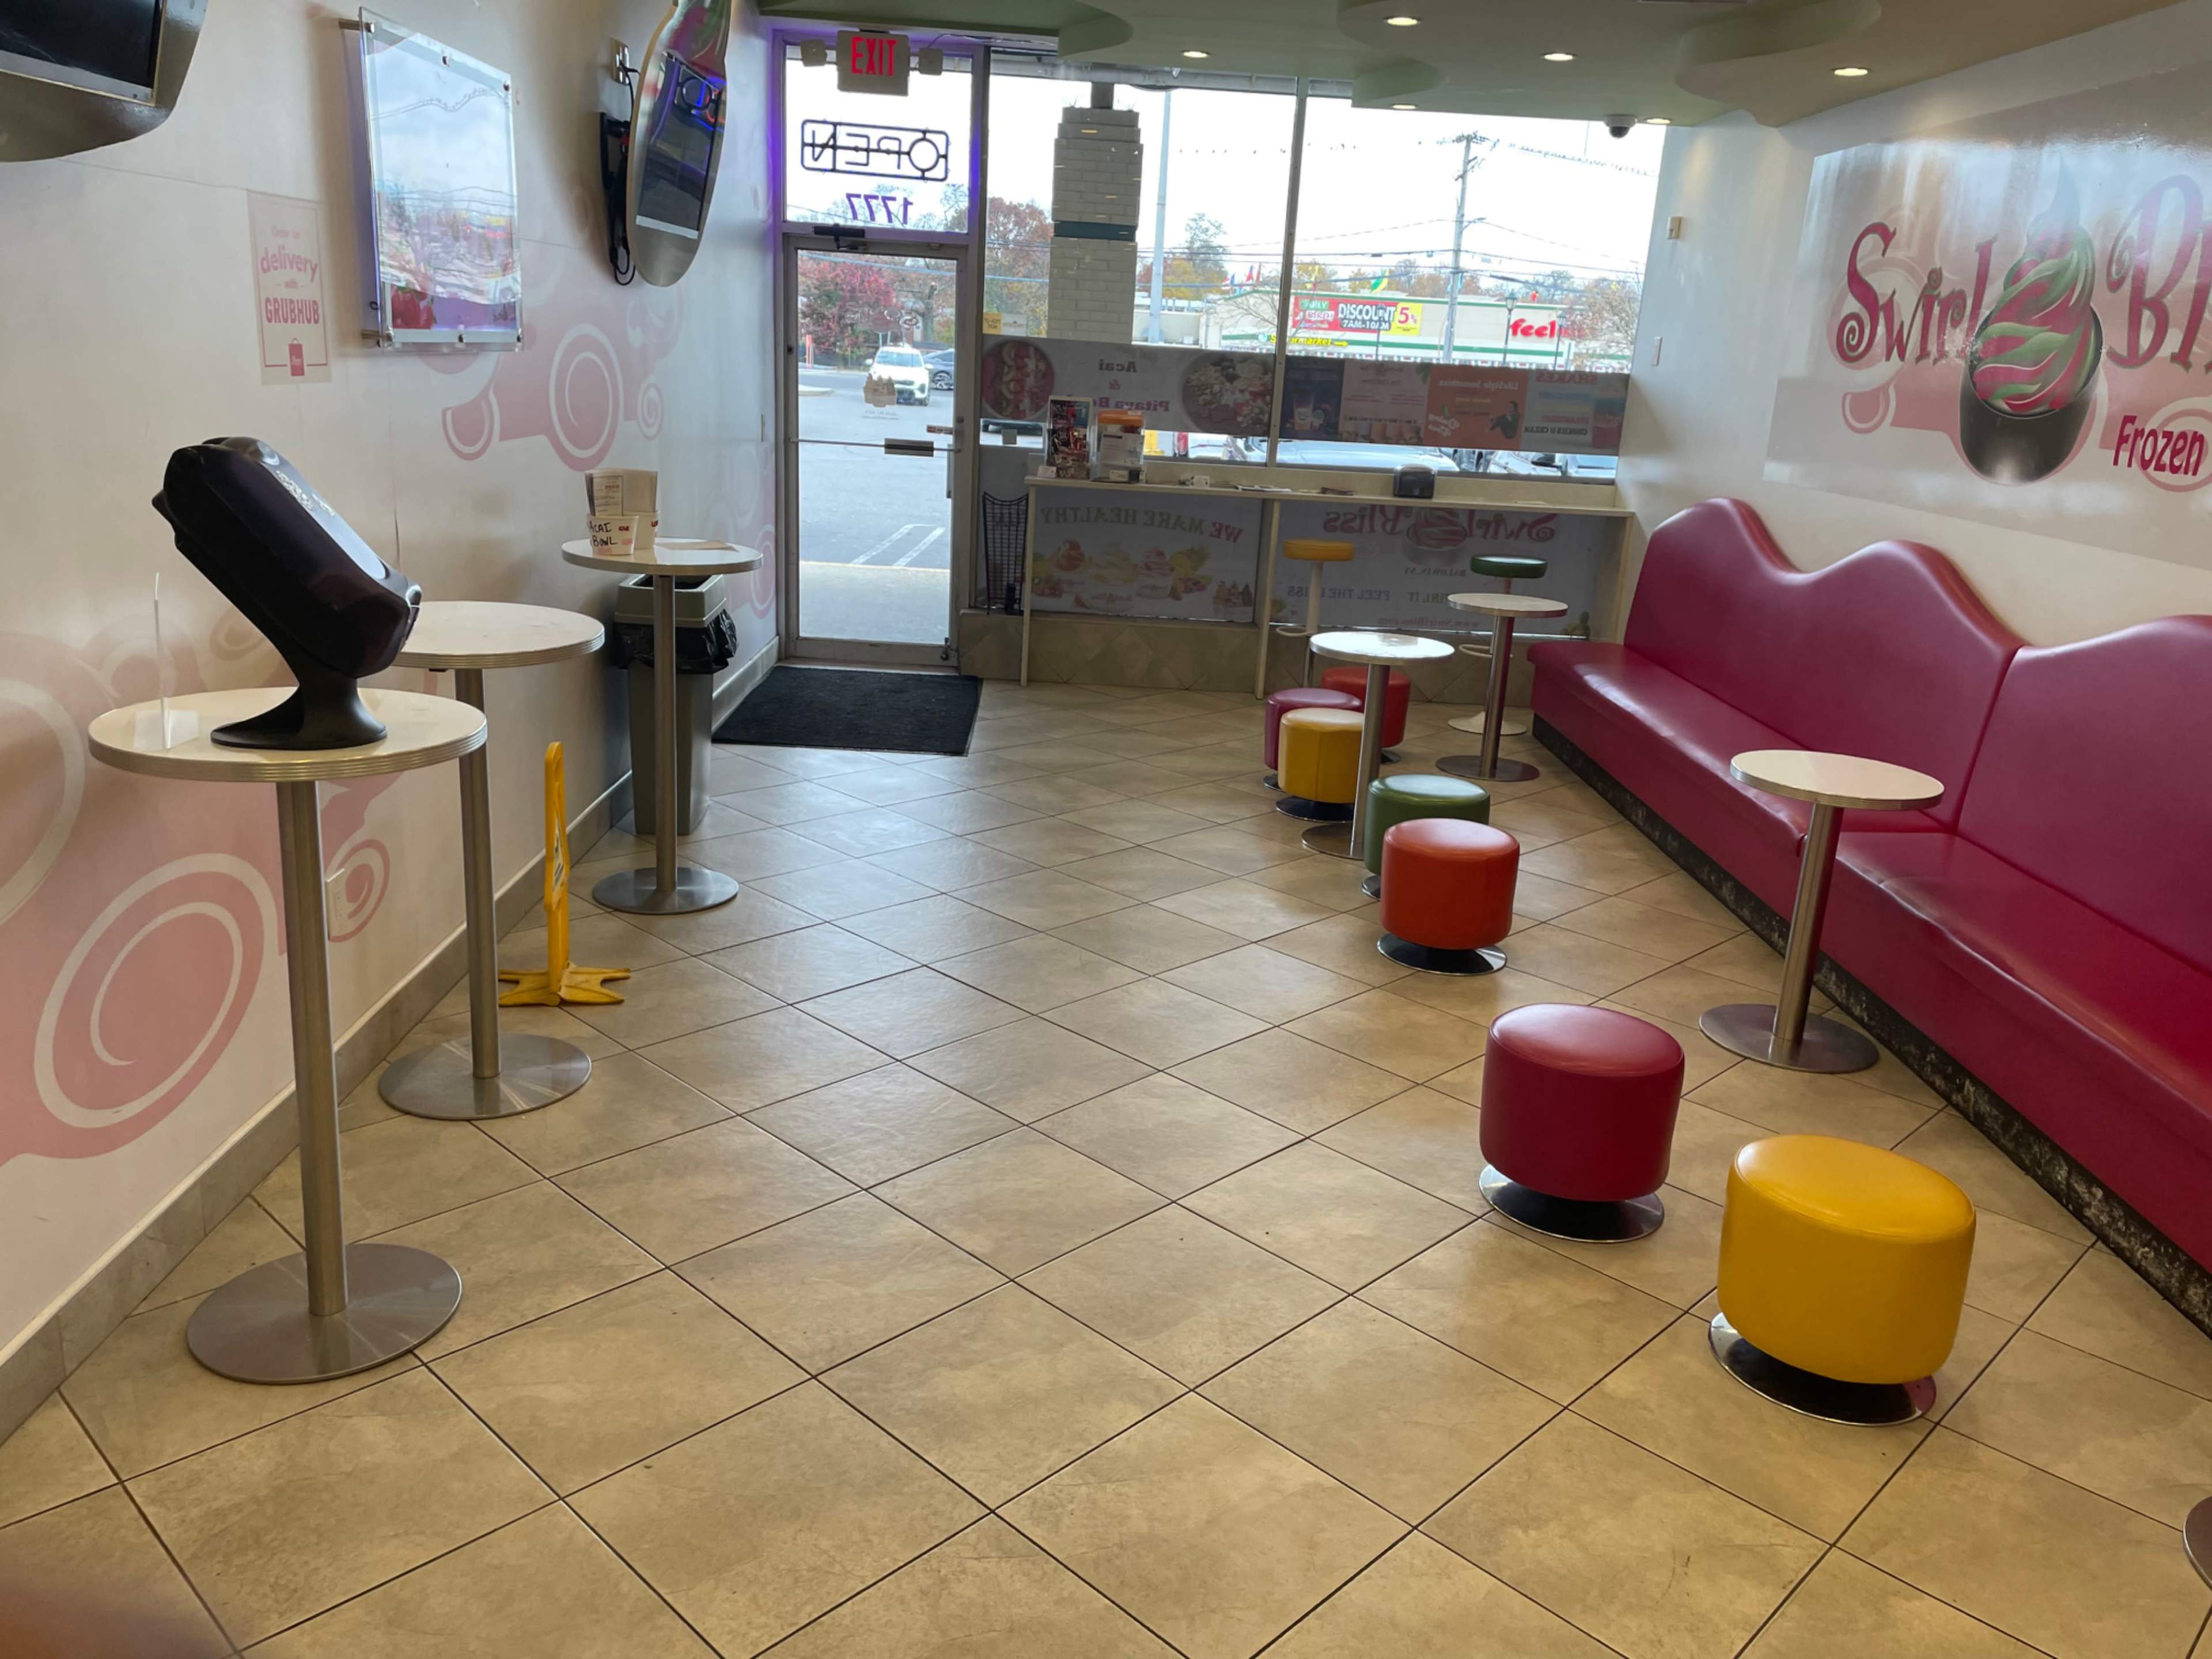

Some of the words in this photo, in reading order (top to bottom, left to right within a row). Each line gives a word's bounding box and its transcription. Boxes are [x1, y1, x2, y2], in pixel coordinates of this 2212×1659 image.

[851, 36, 898, 76] EXIT
[260, 245, 319, 282] delivery
[1836, 221, 1998, 366] Swirl
[2105, 174, 2212, 374] Bl
[264, 297, 320, 324] GRUBHUB
[1338, 304, 1396, 321] DISCOUNT
[1510, 318, 1556, 338] feel
[2113, 415, 2205, 476] Frozen
[589, 521, 612, 533] ACAI
[592, 535, 618, 547] BOWL
